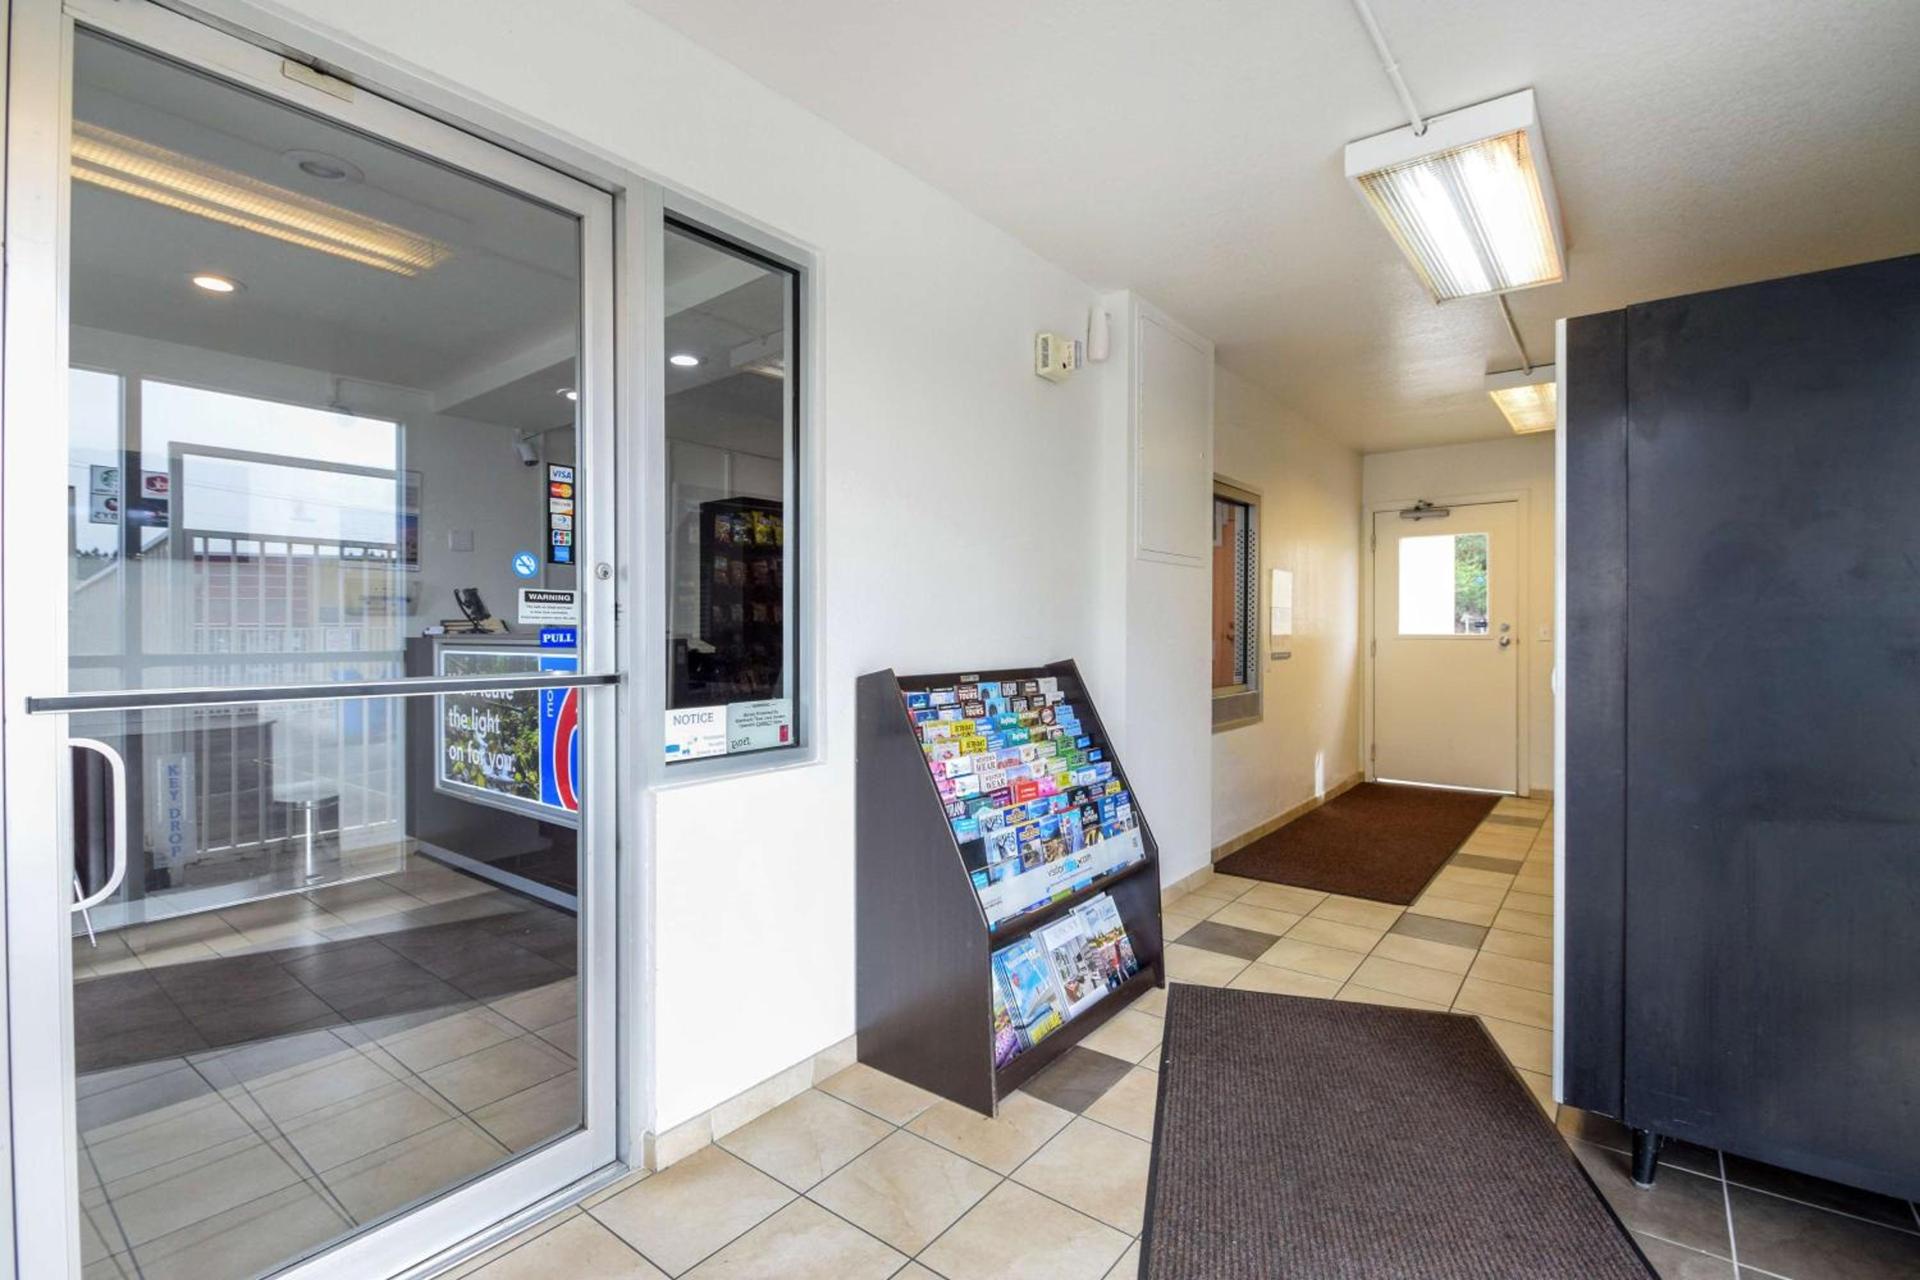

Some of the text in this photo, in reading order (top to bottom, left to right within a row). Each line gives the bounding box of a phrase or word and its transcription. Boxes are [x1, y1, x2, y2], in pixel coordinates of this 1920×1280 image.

[553, 470, 571, 480] VISA
[528, 593, 571, 602] WARNING
[542, 632, 574, 643] PULL
[448, 705, 500, 738] the light
[673, 711, 714, 726] NOTICE
[449, 745, 464, 761] on
[467, 740, 485, 766] for
[168, 765, 182, 858] KEY DROP
